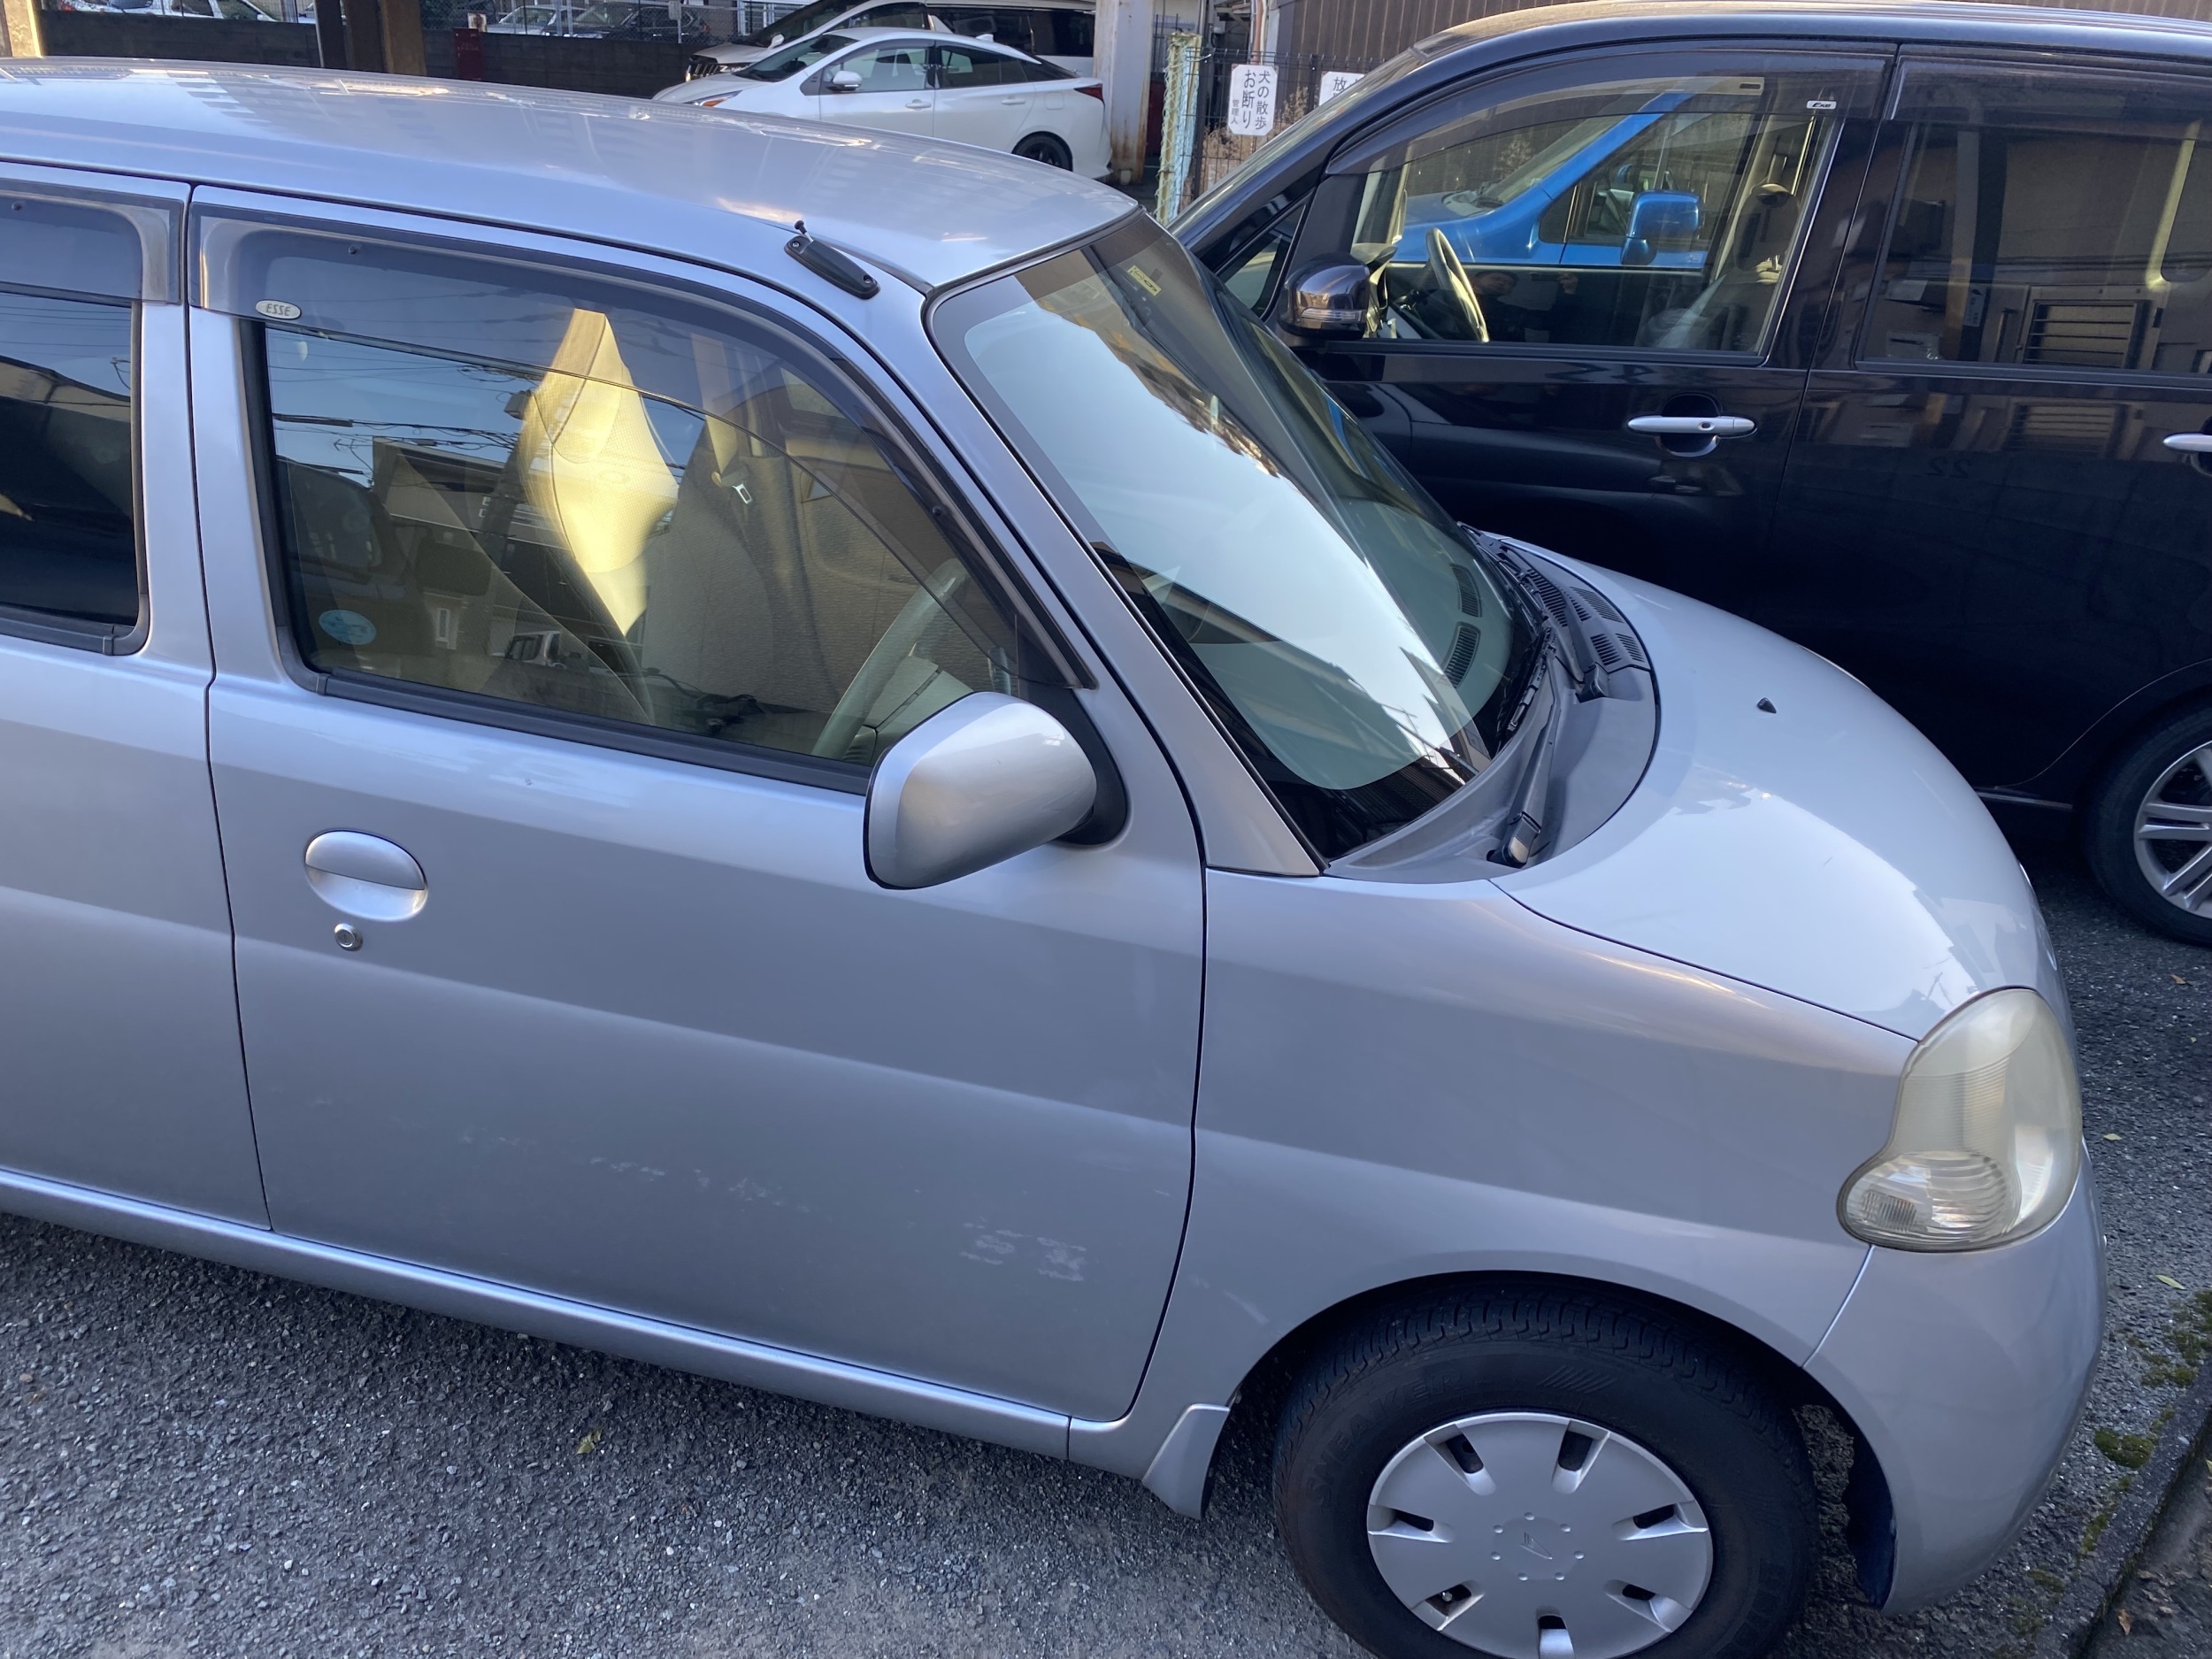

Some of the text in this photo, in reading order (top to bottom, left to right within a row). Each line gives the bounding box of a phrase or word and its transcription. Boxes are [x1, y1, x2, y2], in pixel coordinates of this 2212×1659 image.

[1230, 99, 1240, 125] 管理人
[1241, 69, 1256, 129] お断り
[1255, 70, 1271, 130] 犬の散歩
[1333, 76, 1347, 96] 放
[1305, 1371, 1463, 1510] SNEAKER
